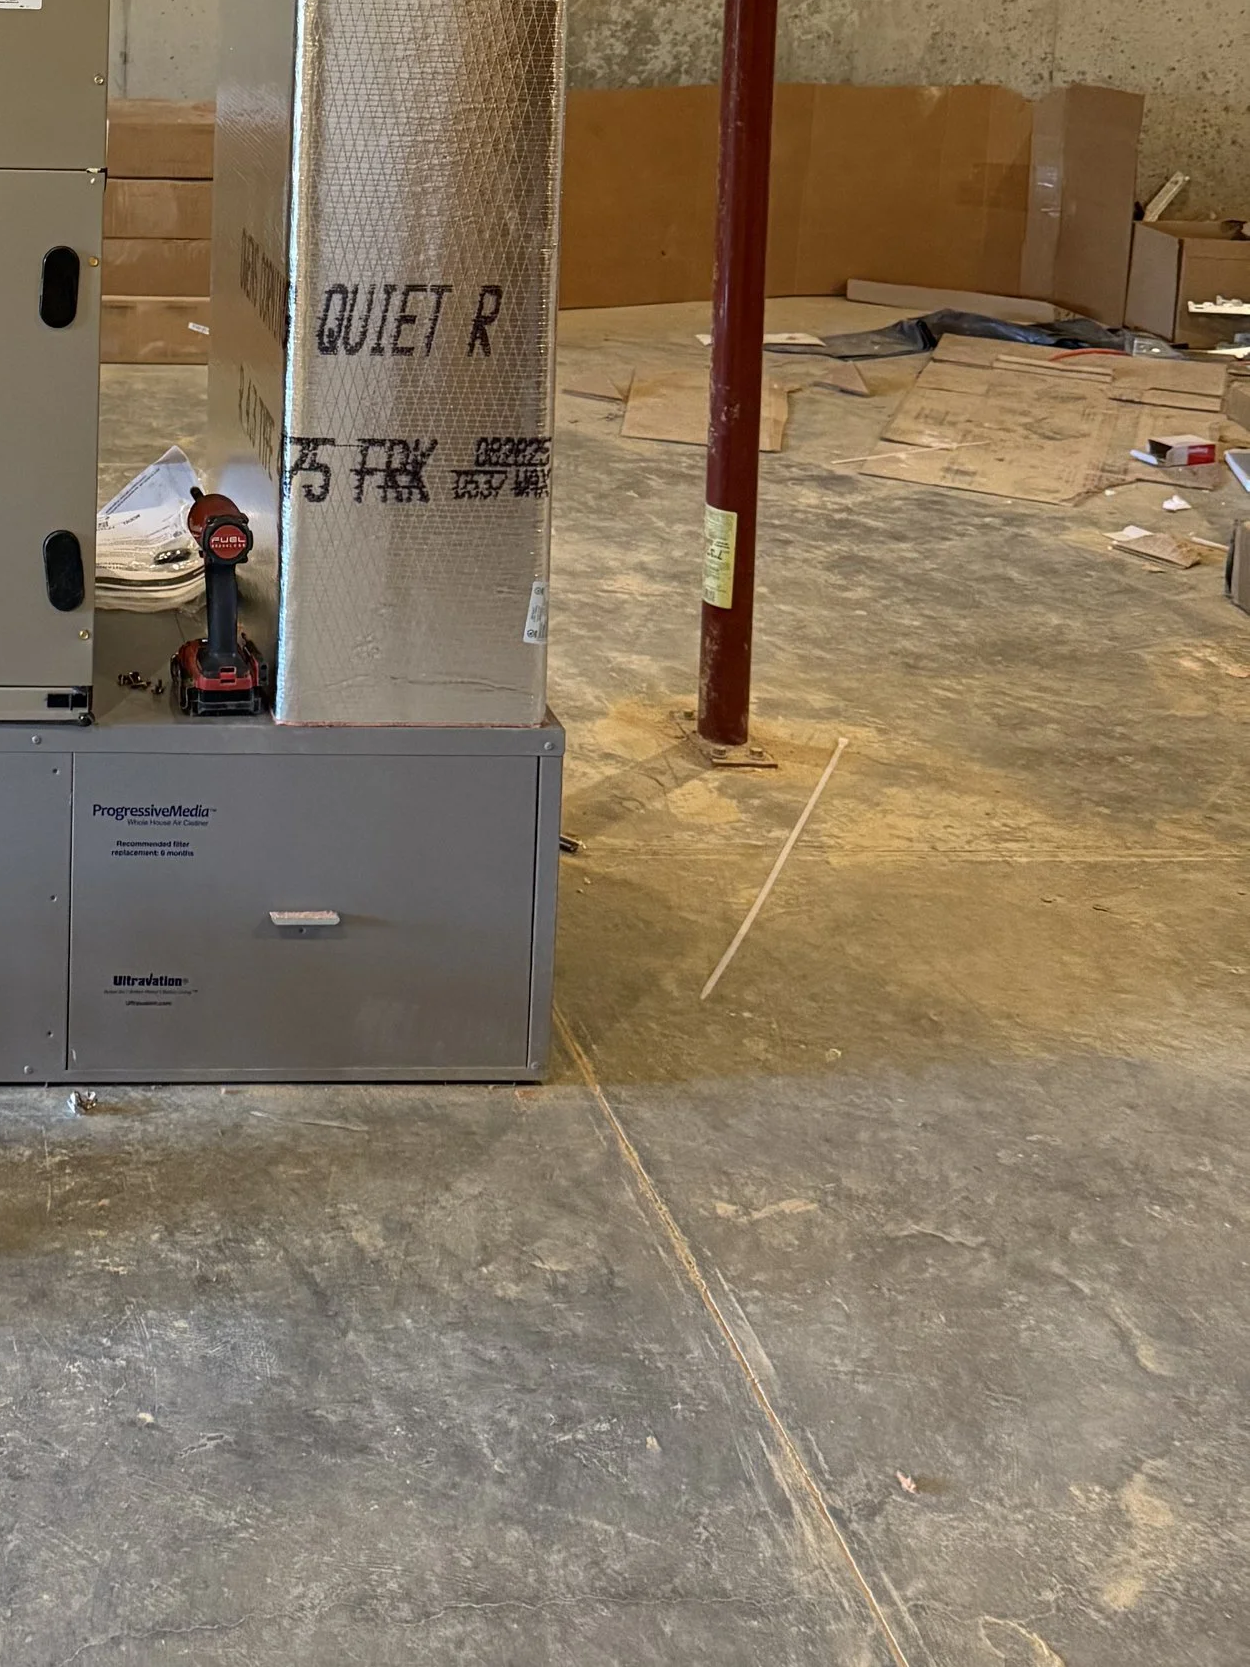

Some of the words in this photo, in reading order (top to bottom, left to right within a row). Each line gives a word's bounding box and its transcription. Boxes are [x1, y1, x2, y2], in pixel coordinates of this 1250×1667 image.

[316, 284, 452, 356] QUIET
[468, 285, 502, 357] R
[350, 438, 438, 503] FRK
[111, 849, 160, 858] replacement:
[116, 840, 172, 848] Recommended
[173, 840, 190, 848] filter
